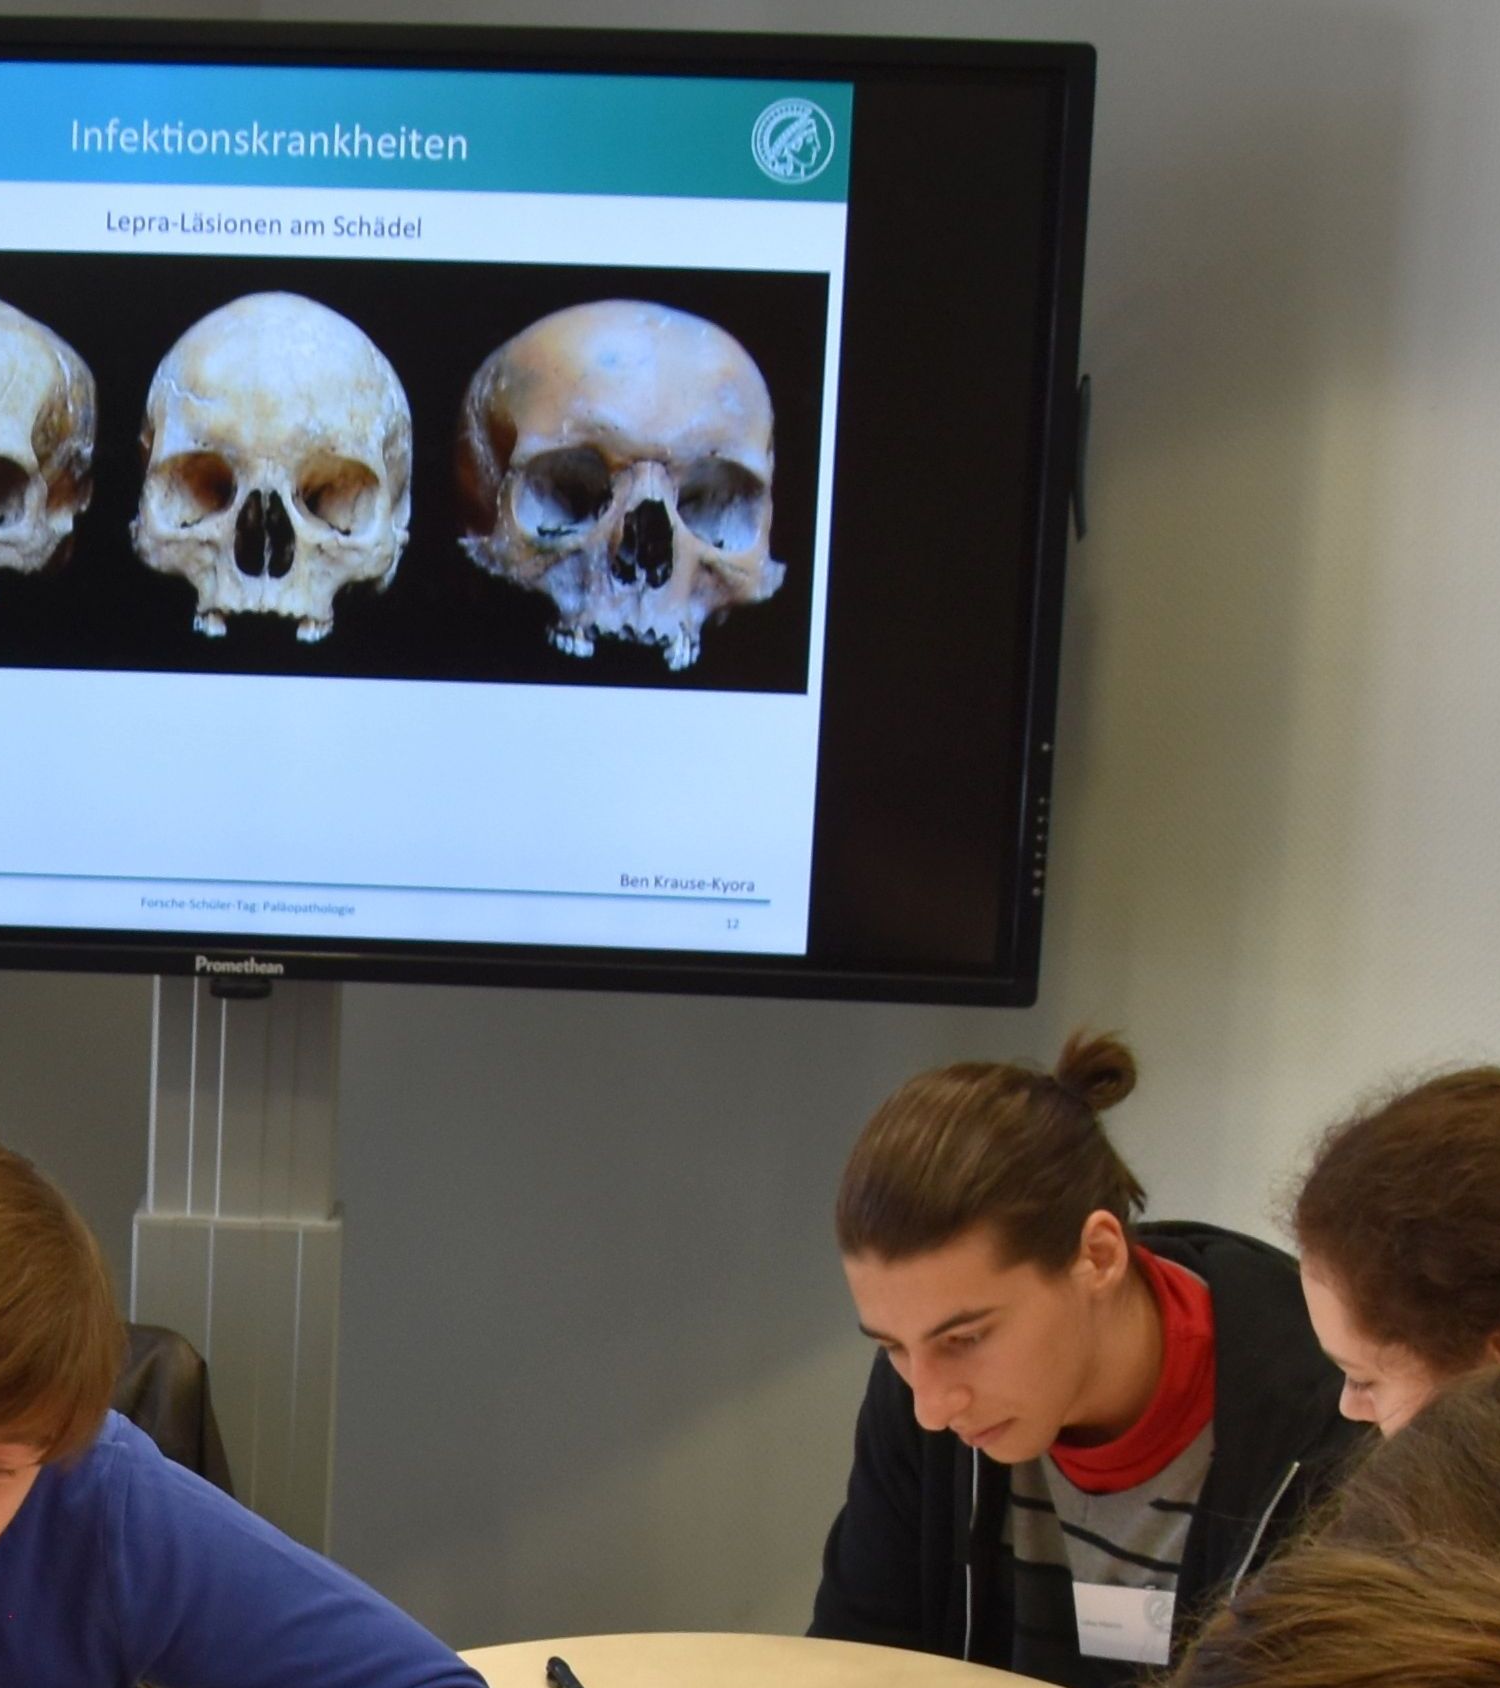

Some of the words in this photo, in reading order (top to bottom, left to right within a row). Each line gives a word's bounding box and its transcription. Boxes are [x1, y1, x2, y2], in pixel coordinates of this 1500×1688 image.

[70, 118, 469, 162] Infektionskrankheiten
[105, 210, 282, 237] Lepra-Läsionen
[290, 219, 325, 236] am
[333, 214, 423, 239] Schädel
[620, 874, 650, 888] Ben
[654, 876, 756, 893] Krause-Kyora
[263, 900, 356, 917] Paläopathologie
[727, 919, 740, 929] 12
[194, 955, 285, 975] Promethean
